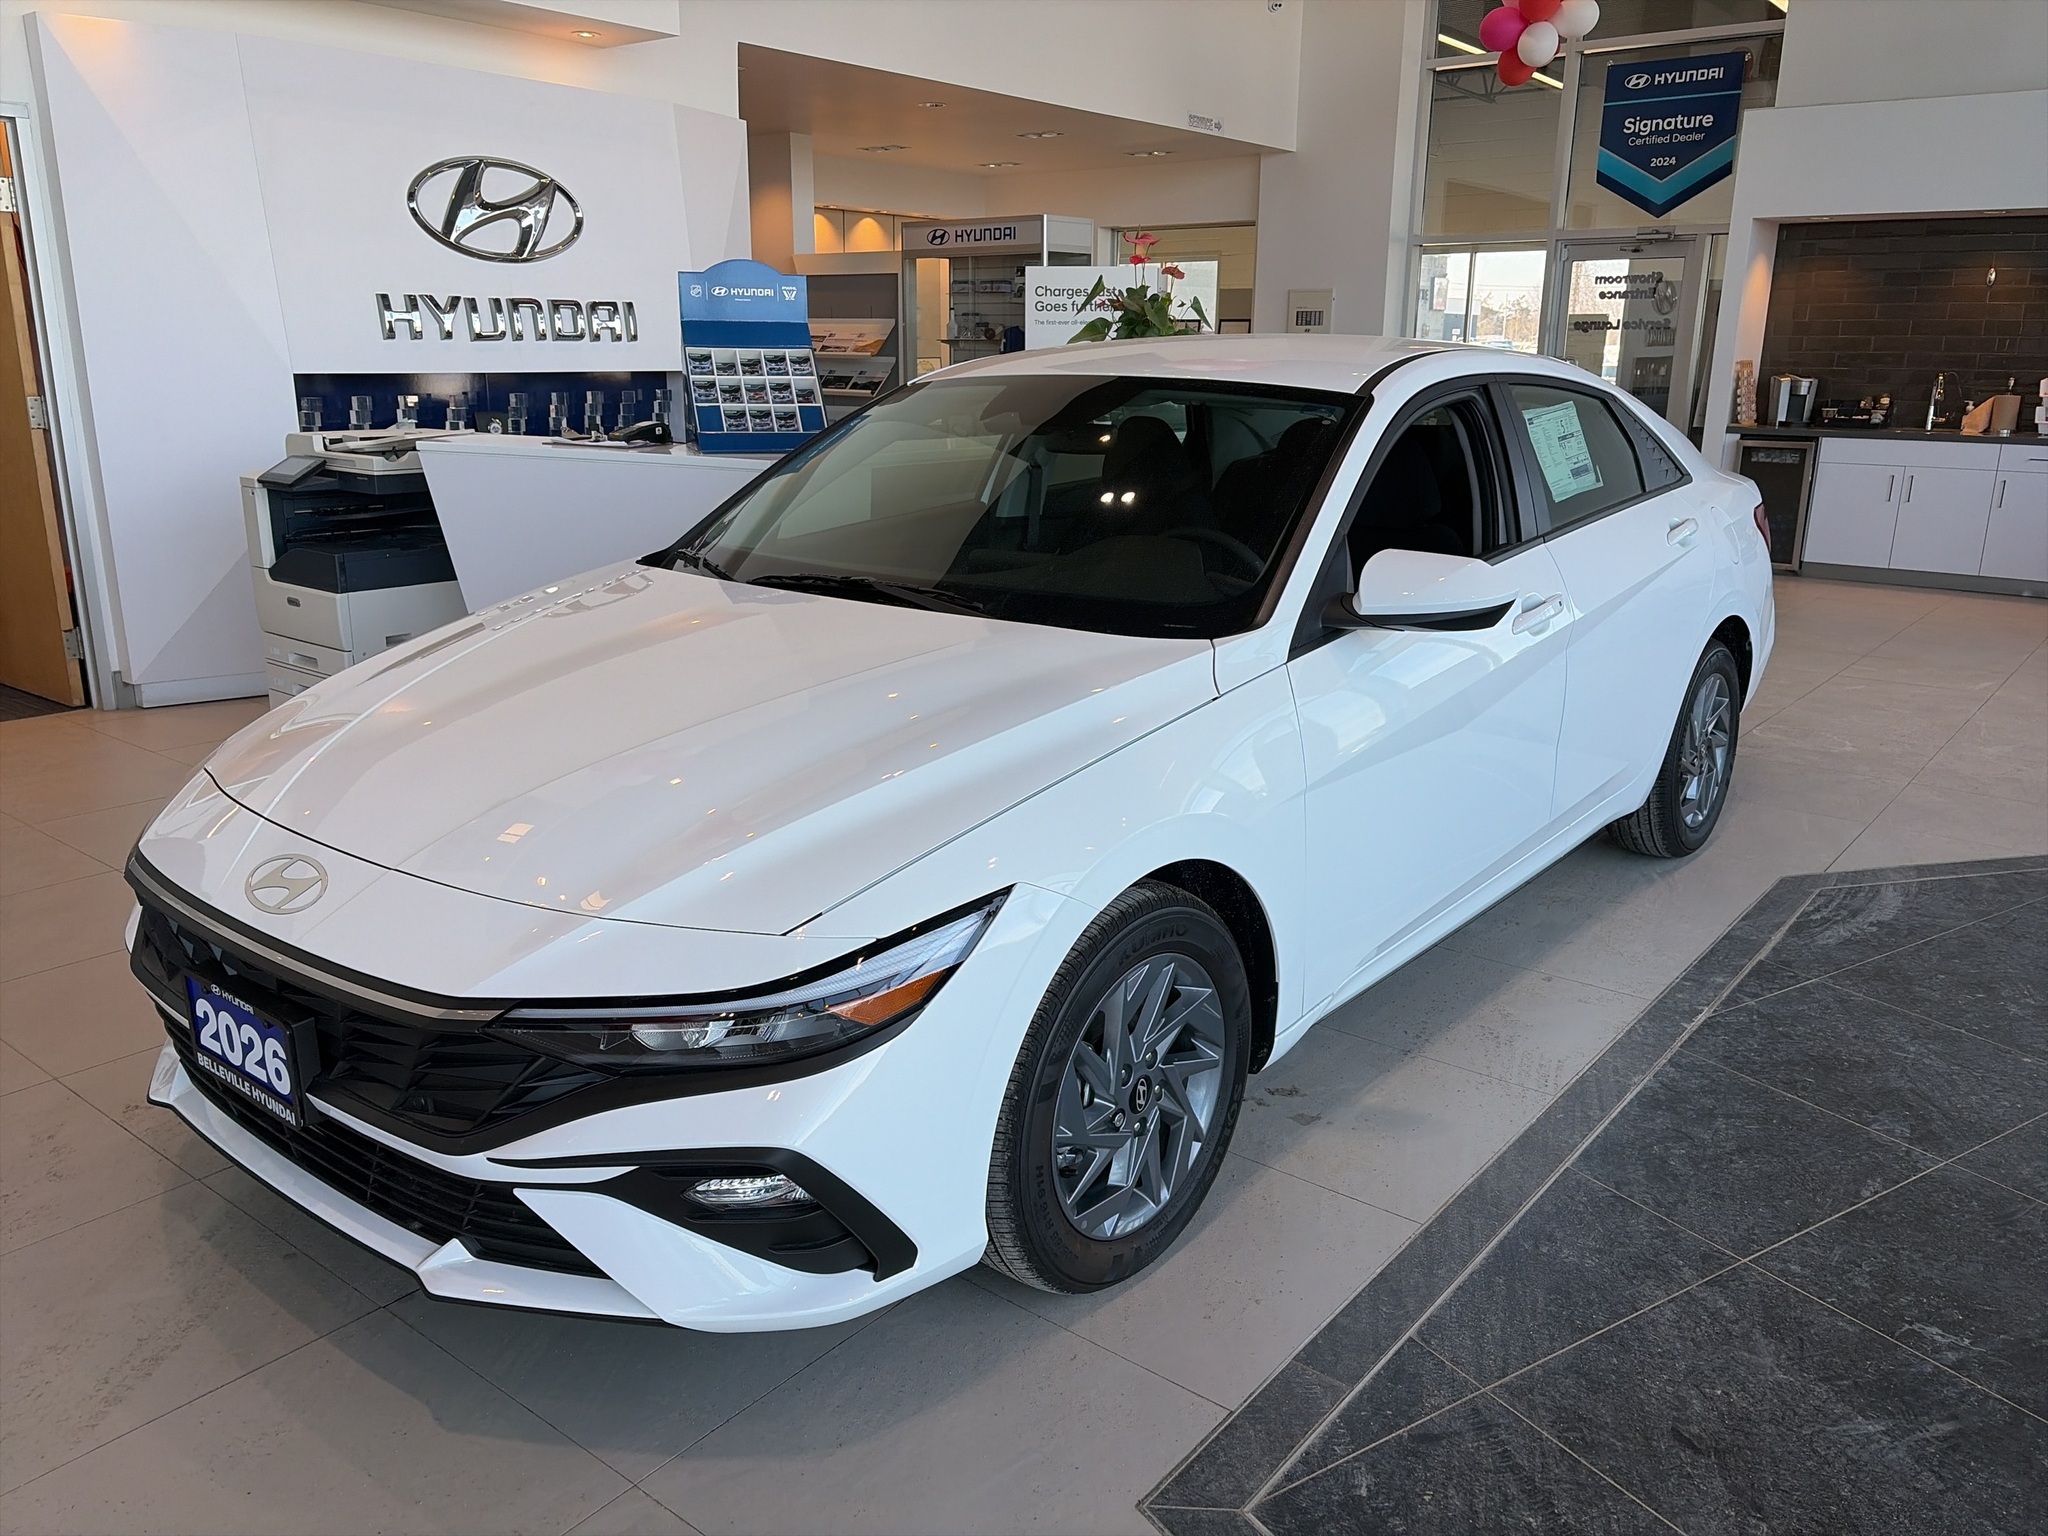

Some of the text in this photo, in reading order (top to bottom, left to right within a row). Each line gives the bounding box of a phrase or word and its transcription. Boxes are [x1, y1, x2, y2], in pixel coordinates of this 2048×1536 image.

[1654, 67, 1724, 86] HYUNDAI
[1623, 113, 1714, 136] Signature
[1628, 131, 1706, 147] Certified Dealer
[1650, 156, 1677, 167] 2024
[955, 226, 1016, 243] HYUNDAI
[730, 288, 774, 297] HYUNDAI
[1034, 286, 1089, 299] Charges
[1034, 301, 1068, 312] Goes
[375, 292, 639, 342] HYUNDAI
[222, 990, 254, 1015] HYUNDAI
[195, 998, 291, 1096] 2026
[197, 1052, 297, 1127] BELLEVILLE HYUNDAI
